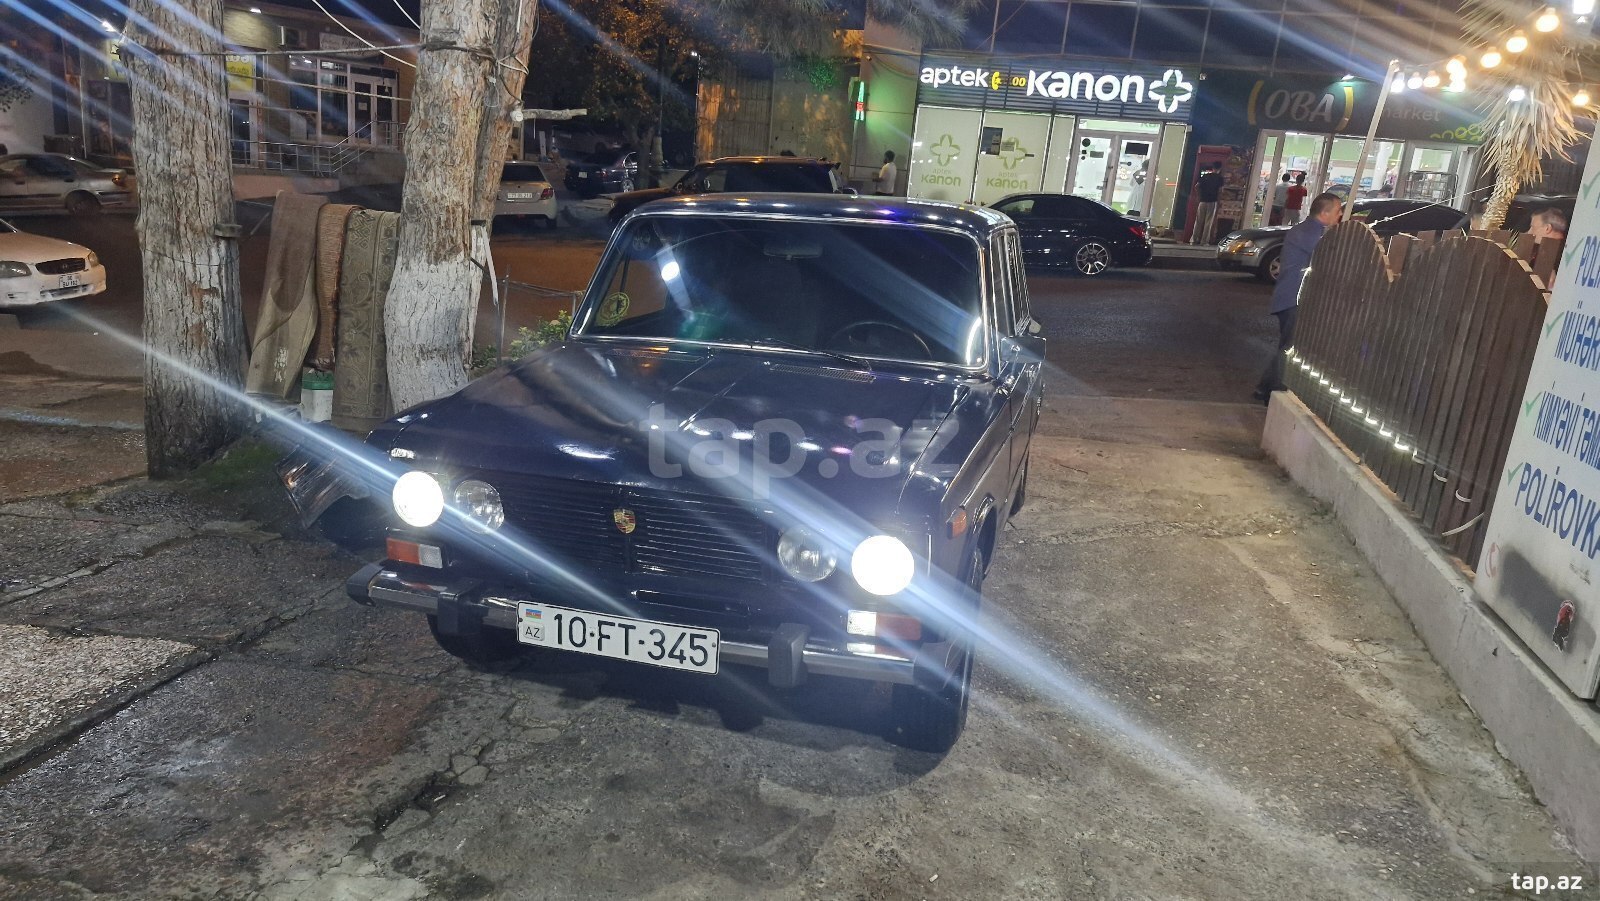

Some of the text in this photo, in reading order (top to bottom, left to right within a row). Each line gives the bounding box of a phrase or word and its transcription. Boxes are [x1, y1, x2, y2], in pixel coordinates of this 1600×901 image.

[920, 66, 990, 88] aptek
[1265, 89, 1335, 122] OBA
[525, 626, 541, 639] AZ
